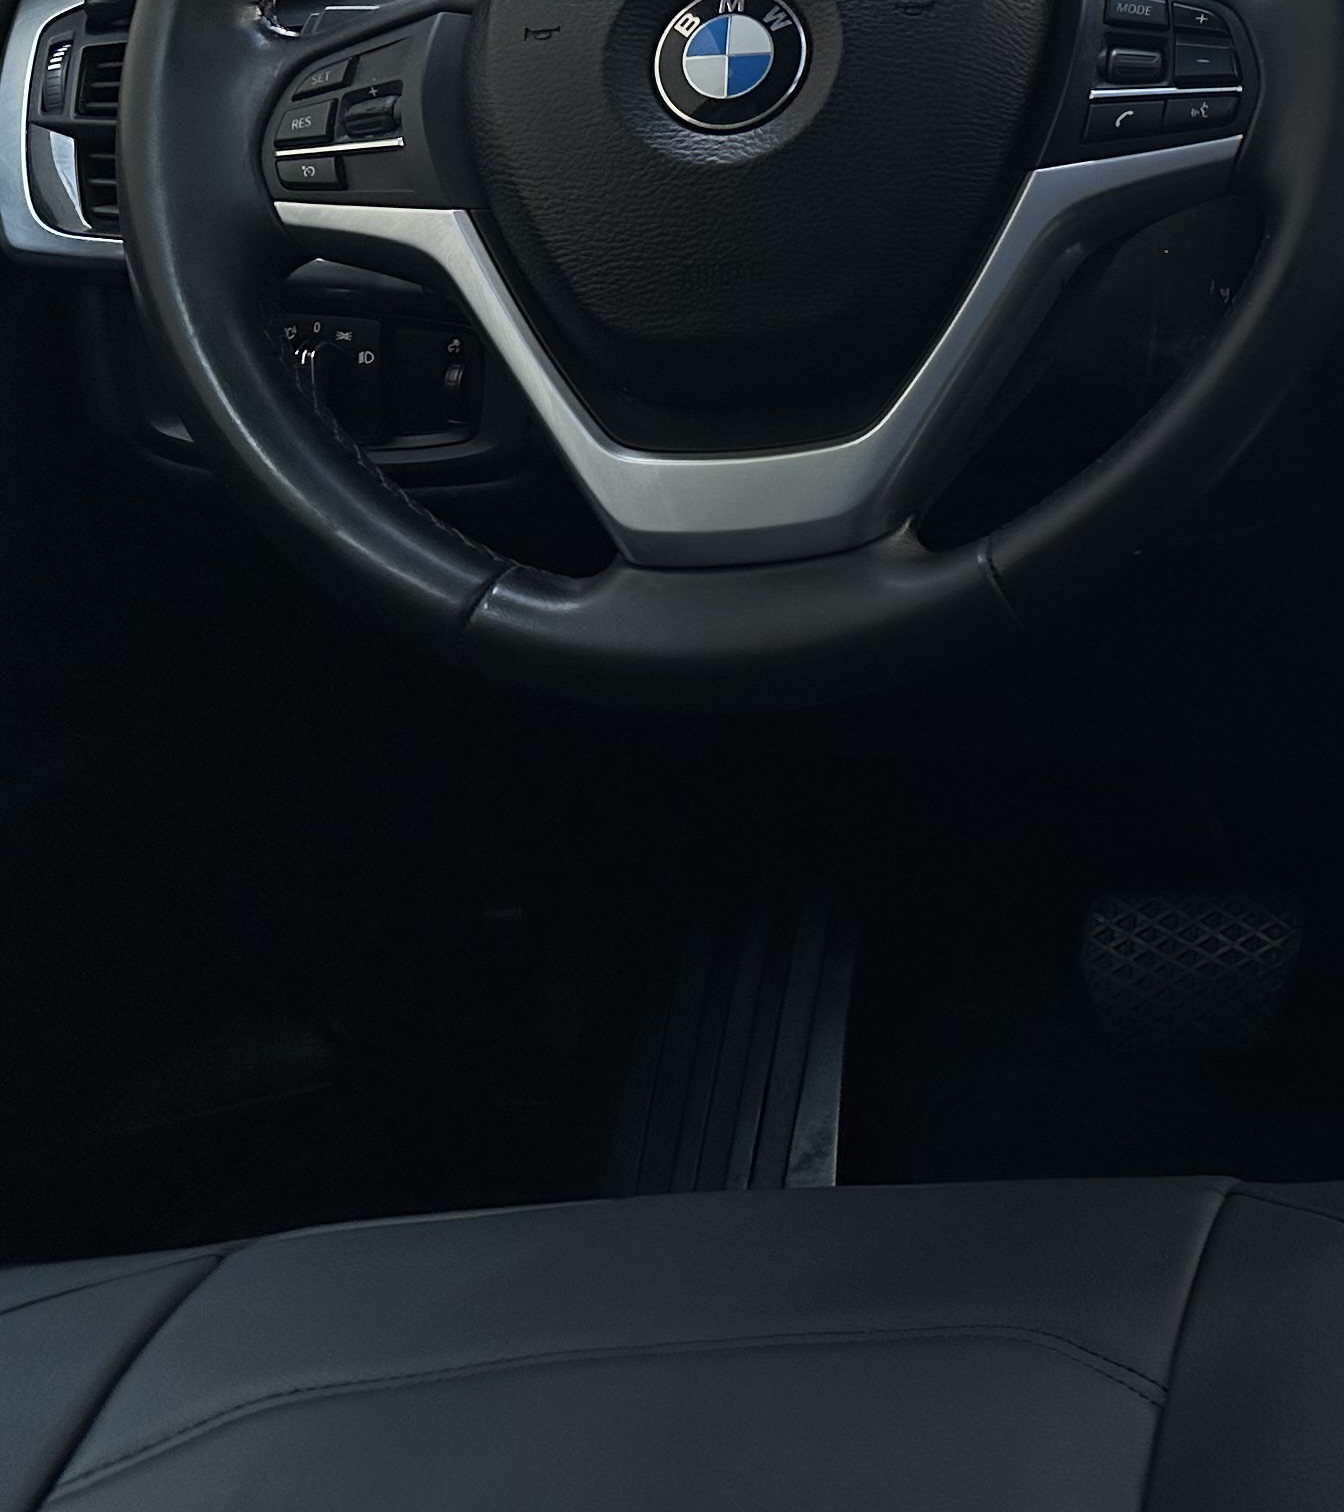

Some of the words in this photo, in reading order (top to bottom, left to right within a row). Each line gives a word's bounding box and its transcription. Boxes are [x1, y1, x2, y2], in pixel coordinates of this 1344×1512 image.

[1115, 2, 1152, 17] MODE
[311, 70, 332, 85] SET
[291, 115, 312, 130] RES
